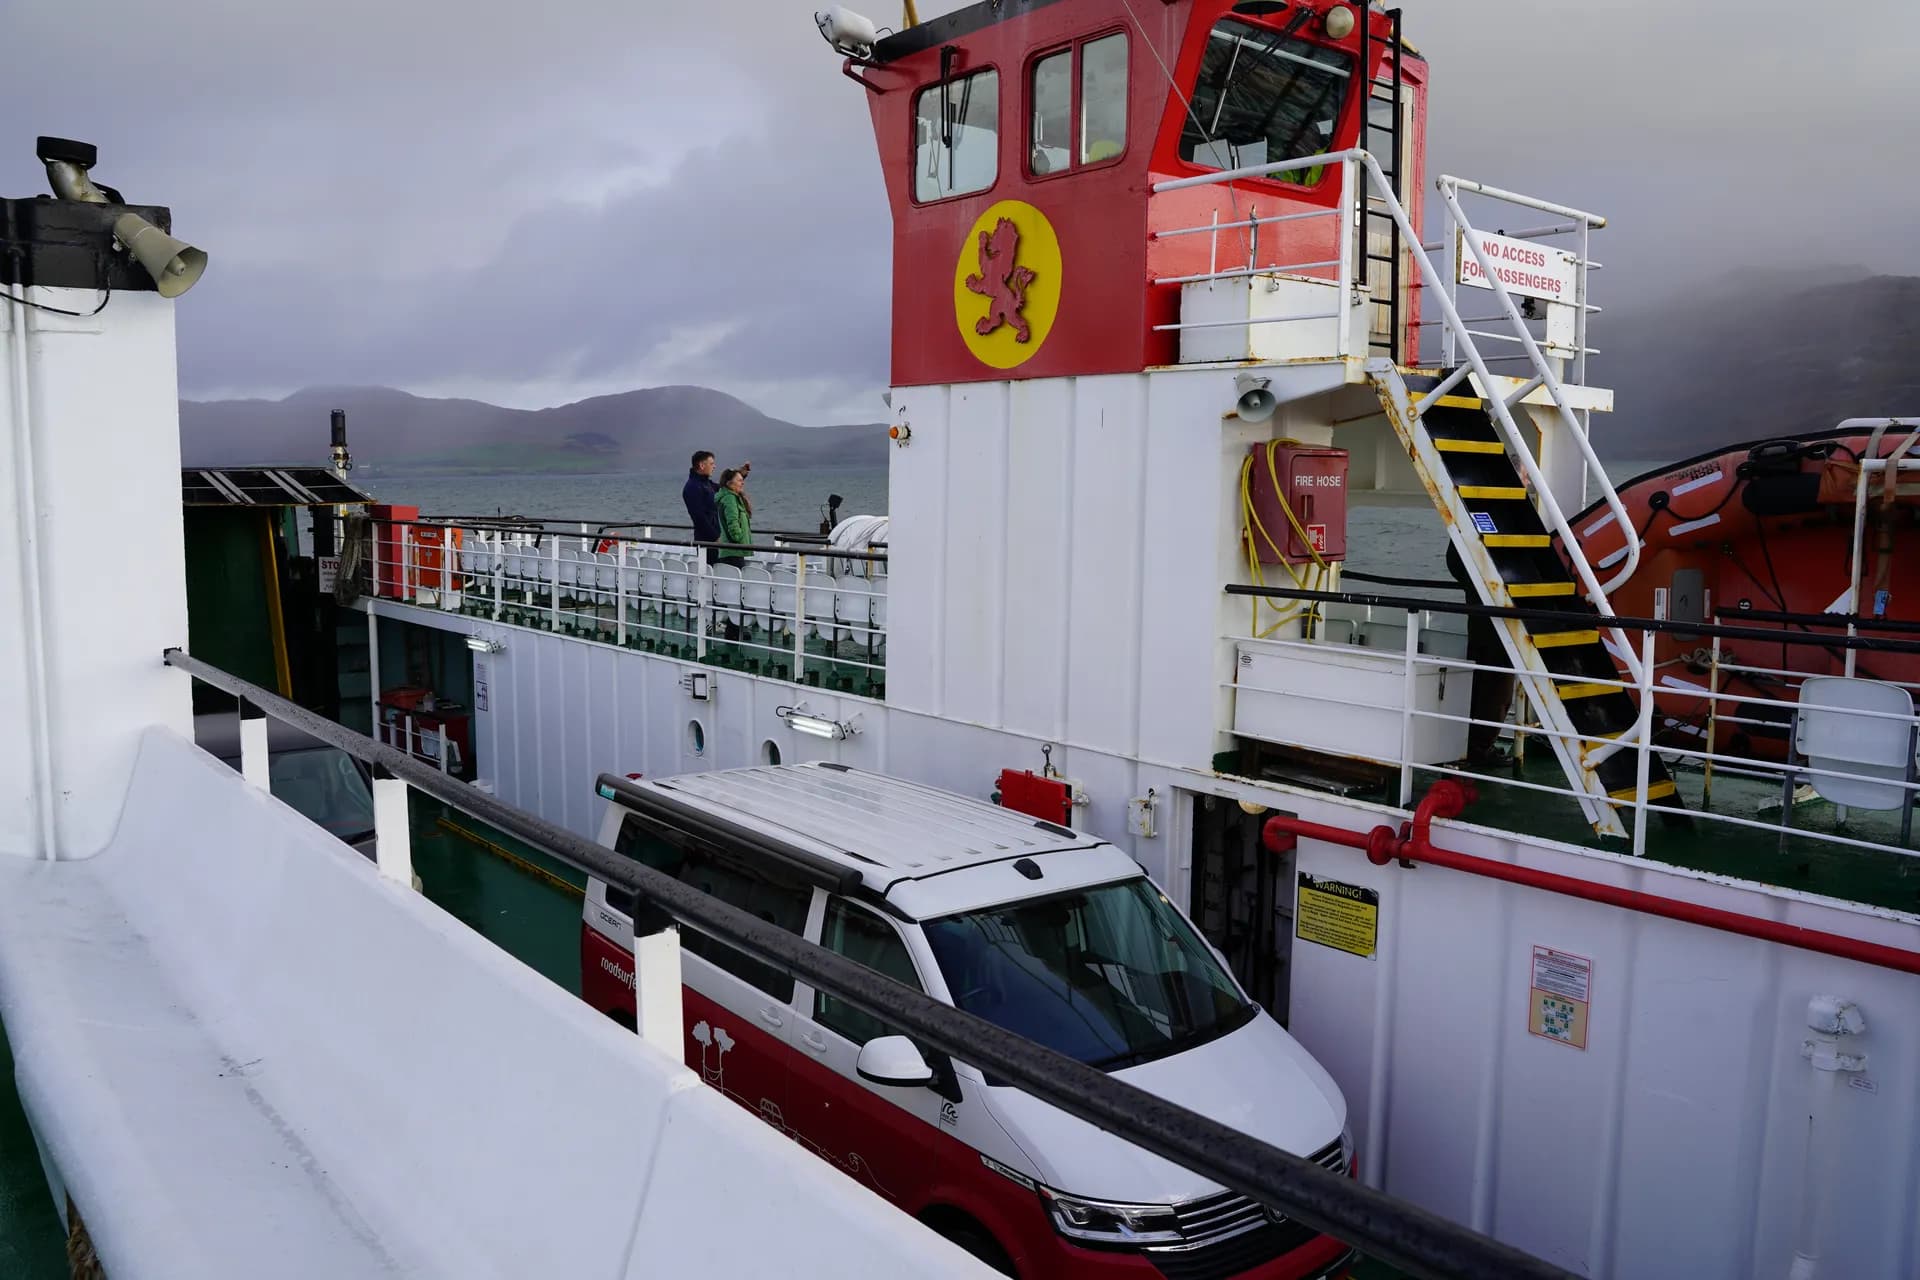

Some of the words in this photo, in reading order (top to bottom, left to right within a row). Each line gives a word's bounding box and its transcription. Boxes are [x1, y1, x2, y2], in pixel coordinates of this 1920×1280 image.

[1483, 240, 1499, 257] NO
[1502, 245, 1545, 268] ACCESS
[1463, 260, 1486, 280] FOR
[1493, 266, 1561, 294] ASSENGERS
[1295, 475, 1313, 487] FIRE
[1316, 475, 1341, 487] HOSE
[321, 560, 339, 570] STO
[1315, 881, 1362, 900] WARNING!
[600, 957, 637, 991] roadsurfe
